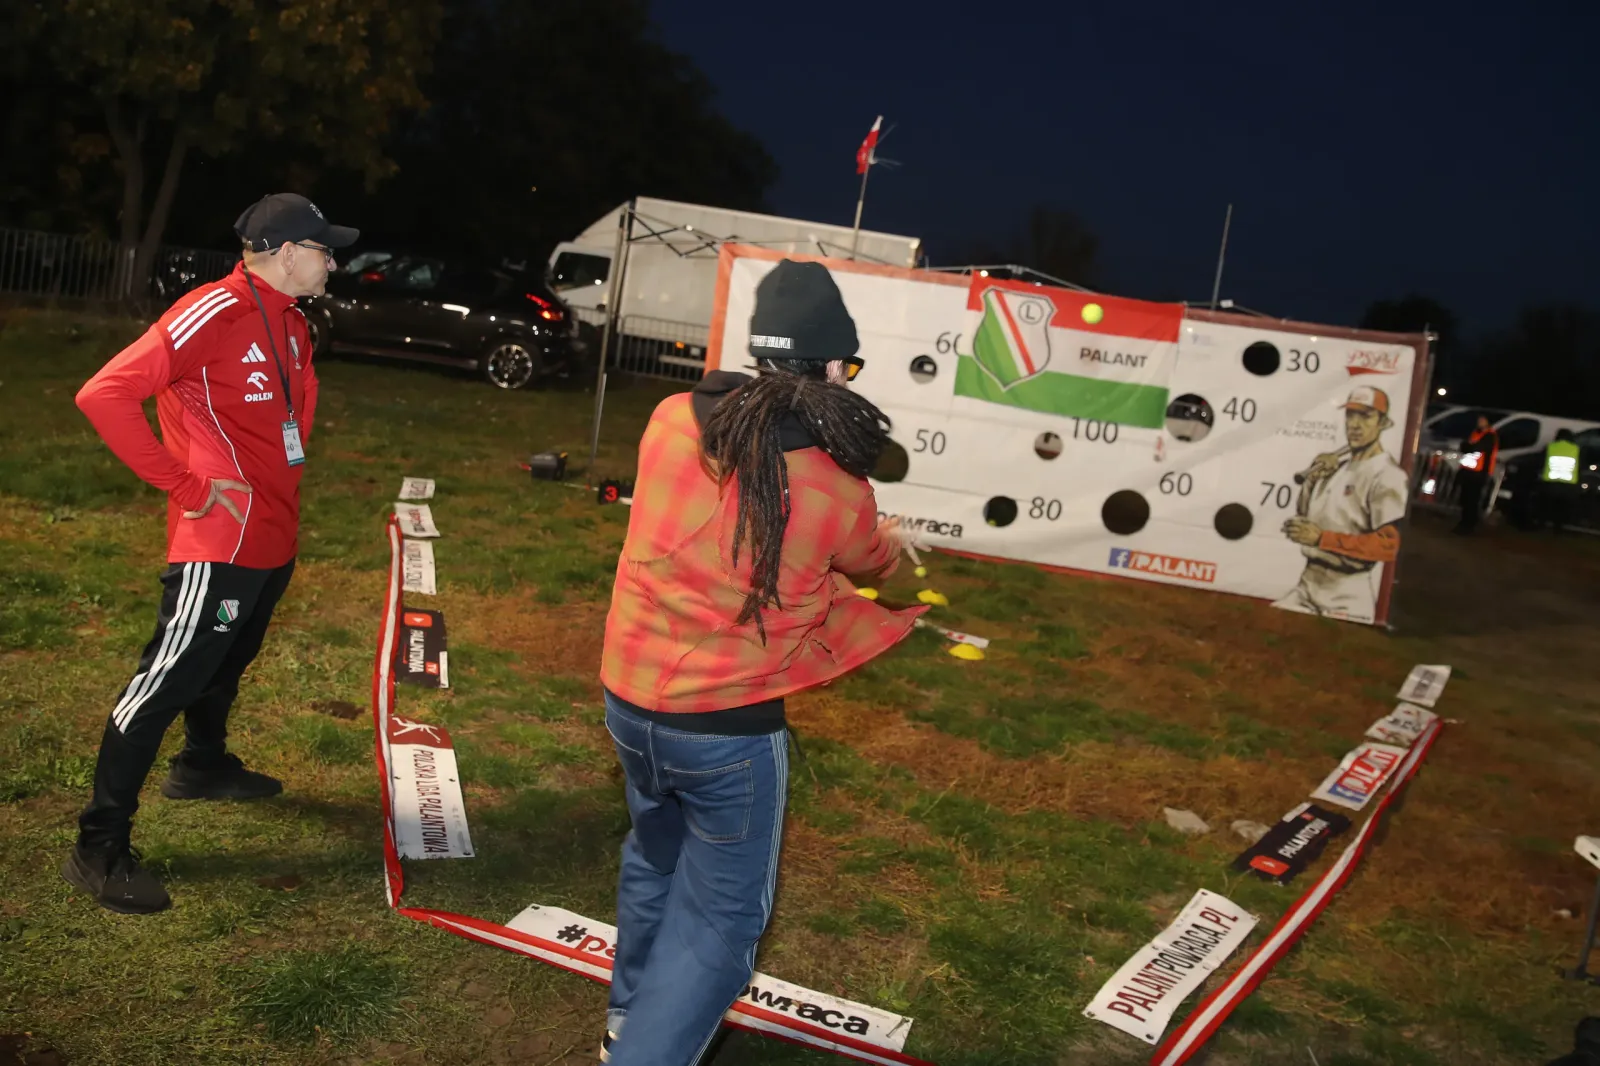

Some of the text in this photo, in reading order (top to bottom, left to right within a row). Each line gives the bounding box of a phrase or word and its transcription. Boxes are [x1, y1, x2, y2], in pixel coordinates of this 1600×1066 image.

[1079, 346, 1148, 368] PALANT
[1285, 349, 1320, 373] 30
[244, 391, 273, 402] ORLEN
[1222, 397, 1257, 423] 40
[913, 428, 947, 455] 50
[1071, 416, 1119, 444] 100
[604, 485, 618, 502] 3
[1159, 471, 1193, 496] 60
[1259, 482, 1292, 509] 70
[1028, 497, 1063, 521] 80
[413, 748, 449, 854] POLSKA LIGA PALANTOWA
[1107, 906, 1239, 1023] PALANTPOWRACA.PL
